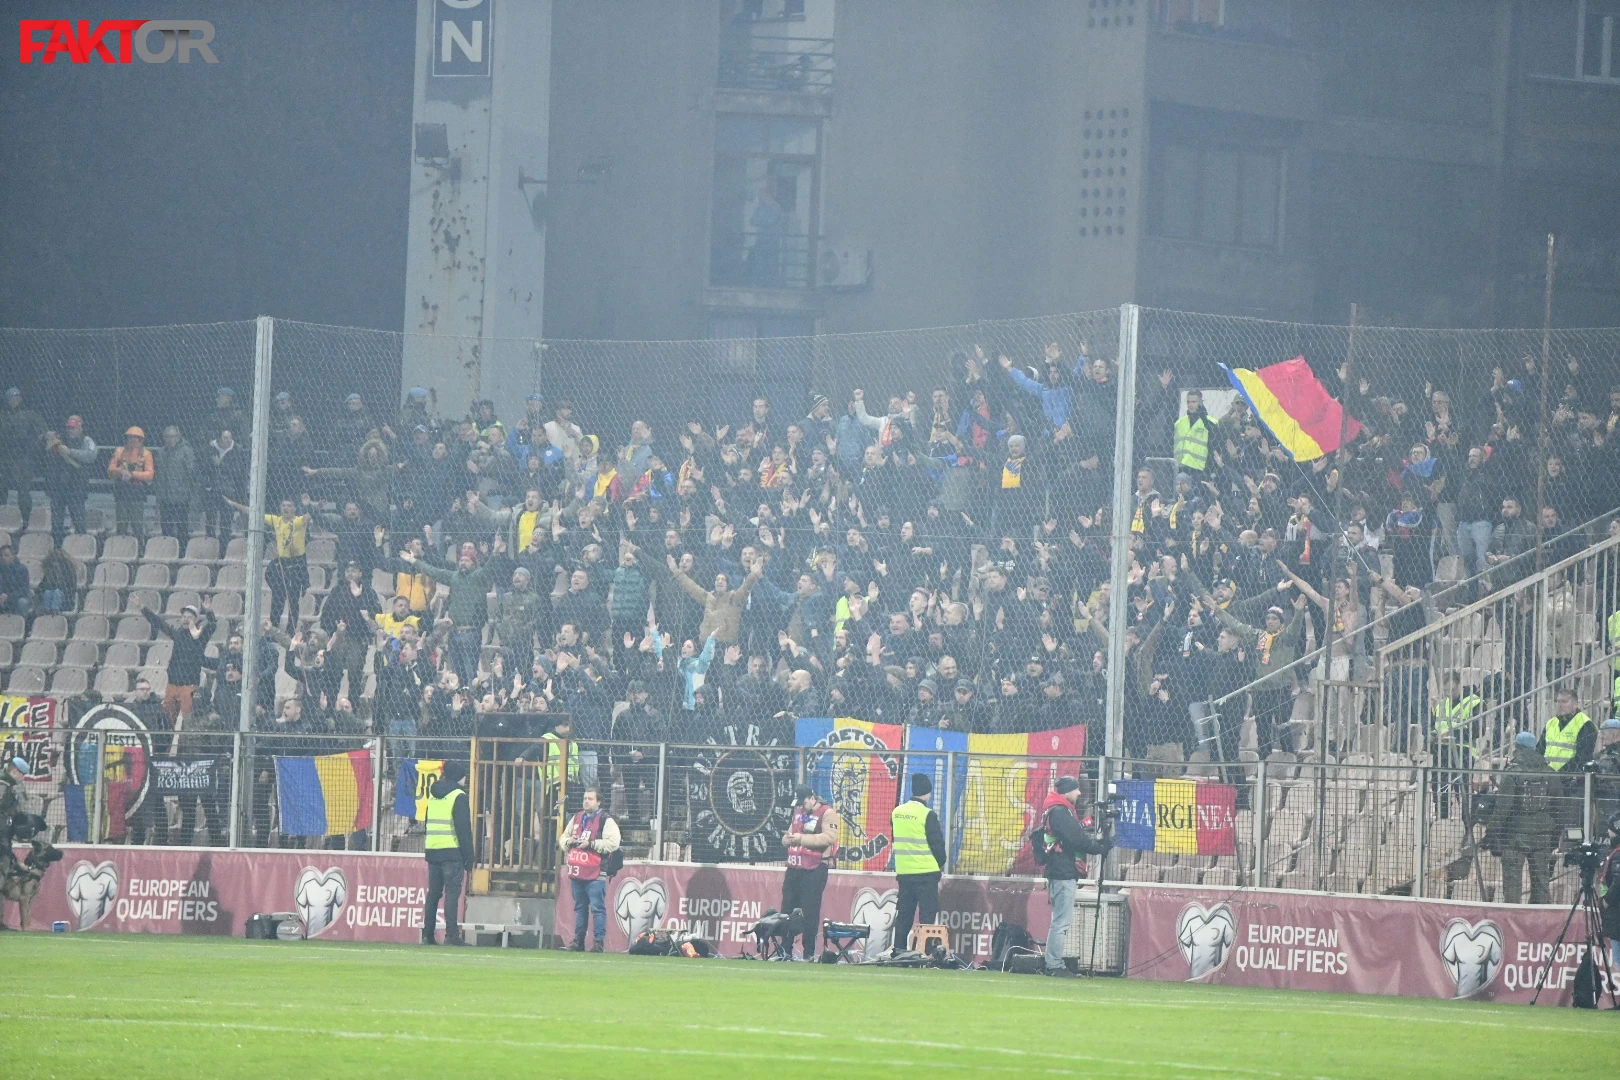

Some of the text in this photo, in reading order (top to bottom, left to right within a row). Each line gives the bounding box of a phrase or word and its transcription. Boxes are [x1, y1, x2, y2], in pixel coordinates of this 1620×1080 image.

[88, 732, 136, 746] PLIESTI
[894, 813, 918, 821] SECURITY
[1119, 799, 1234, 830] MARGINEA
[129, 878, 210, 898] EUROPEAN
[356, 884, 429, 905] EUROPEA
[116, 898, 218, 922] QUALIFIERS
[346, 905, 446, 929] QUALIFIES
[679, 898, 762, 919] EUROPEAN
[934, 910, 1003, 931] ROPEAN
[666, 918, 758, 943] QUALIFIER
[1248, 923, 1338, 948] EUROPEAN
[1236, 945, 1348, 975] QUALIFIERS
[1504, 964, 1620, 996] QUALIFRS
